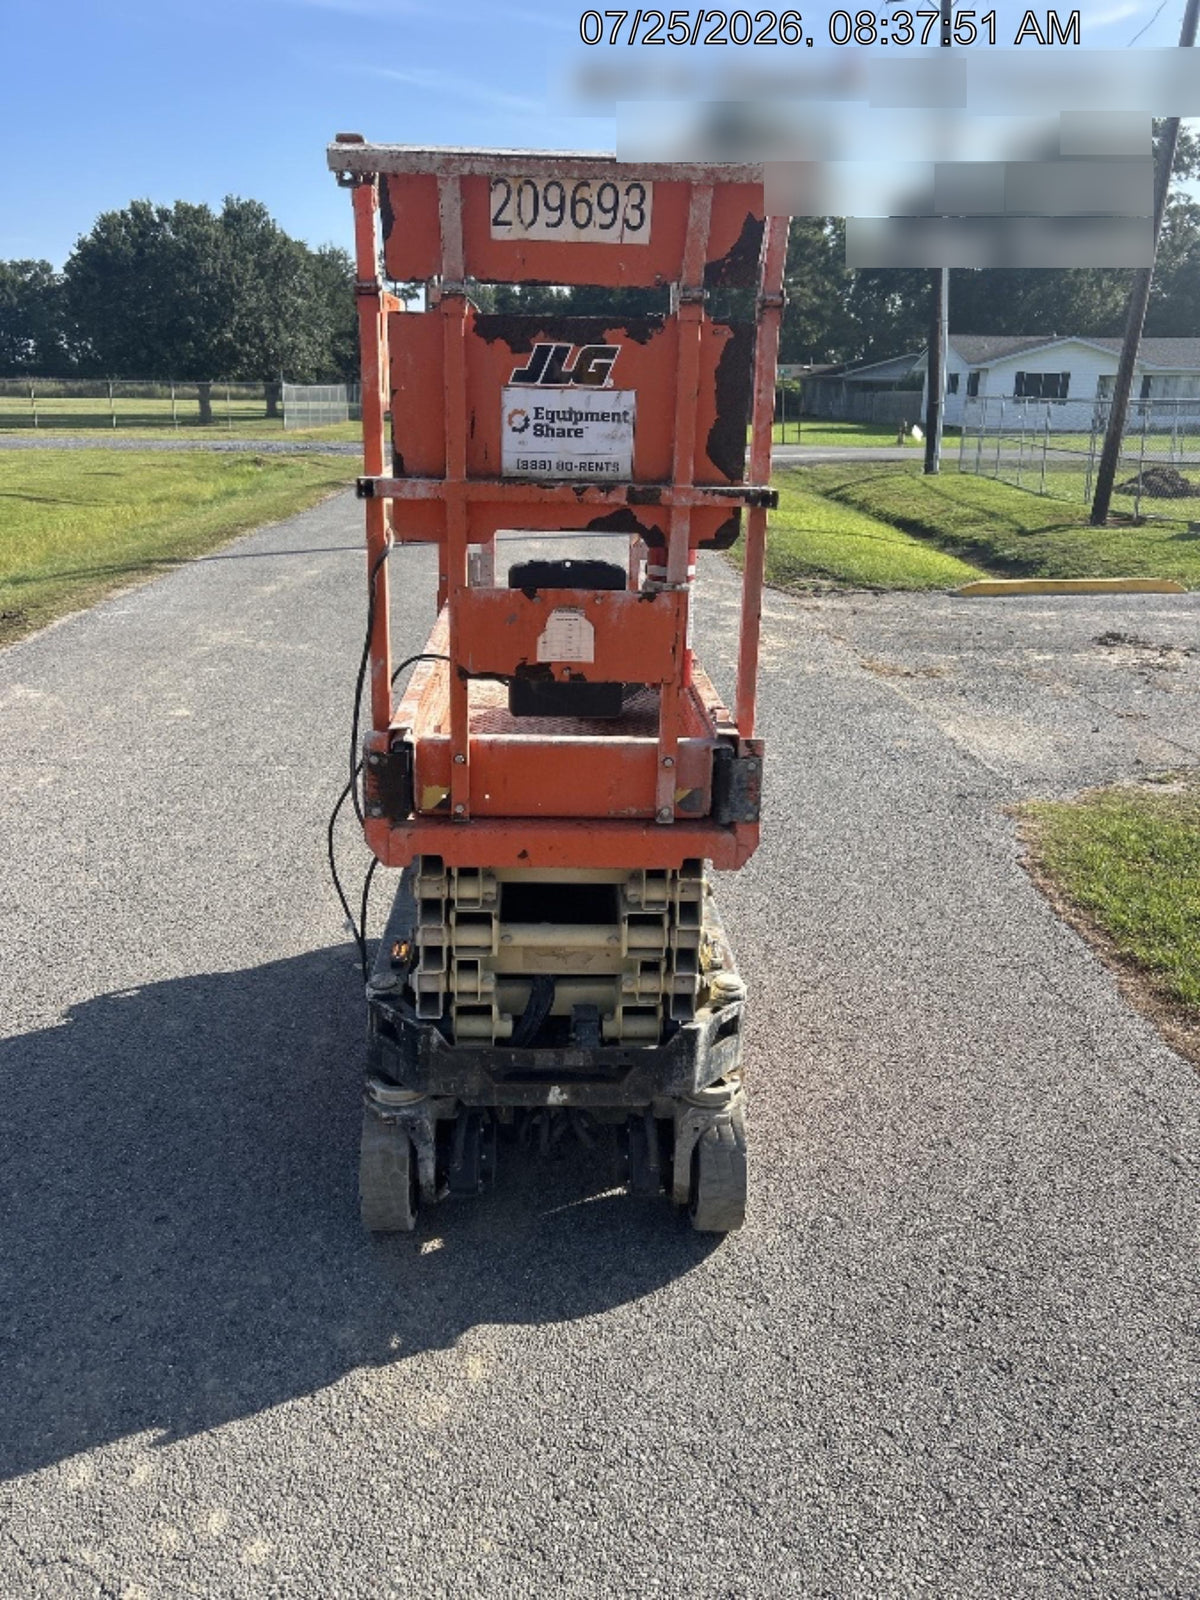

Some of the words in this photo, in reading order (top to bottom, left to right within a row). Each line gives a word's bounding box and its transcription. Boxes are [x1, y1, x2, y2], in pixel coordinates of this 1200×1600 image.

[492, 178, 646, 231] 209693
[508, 343, 621, 388] JLG
[533, 406, 630, 425] Equipment
[533, 423, 584, 439] Share
